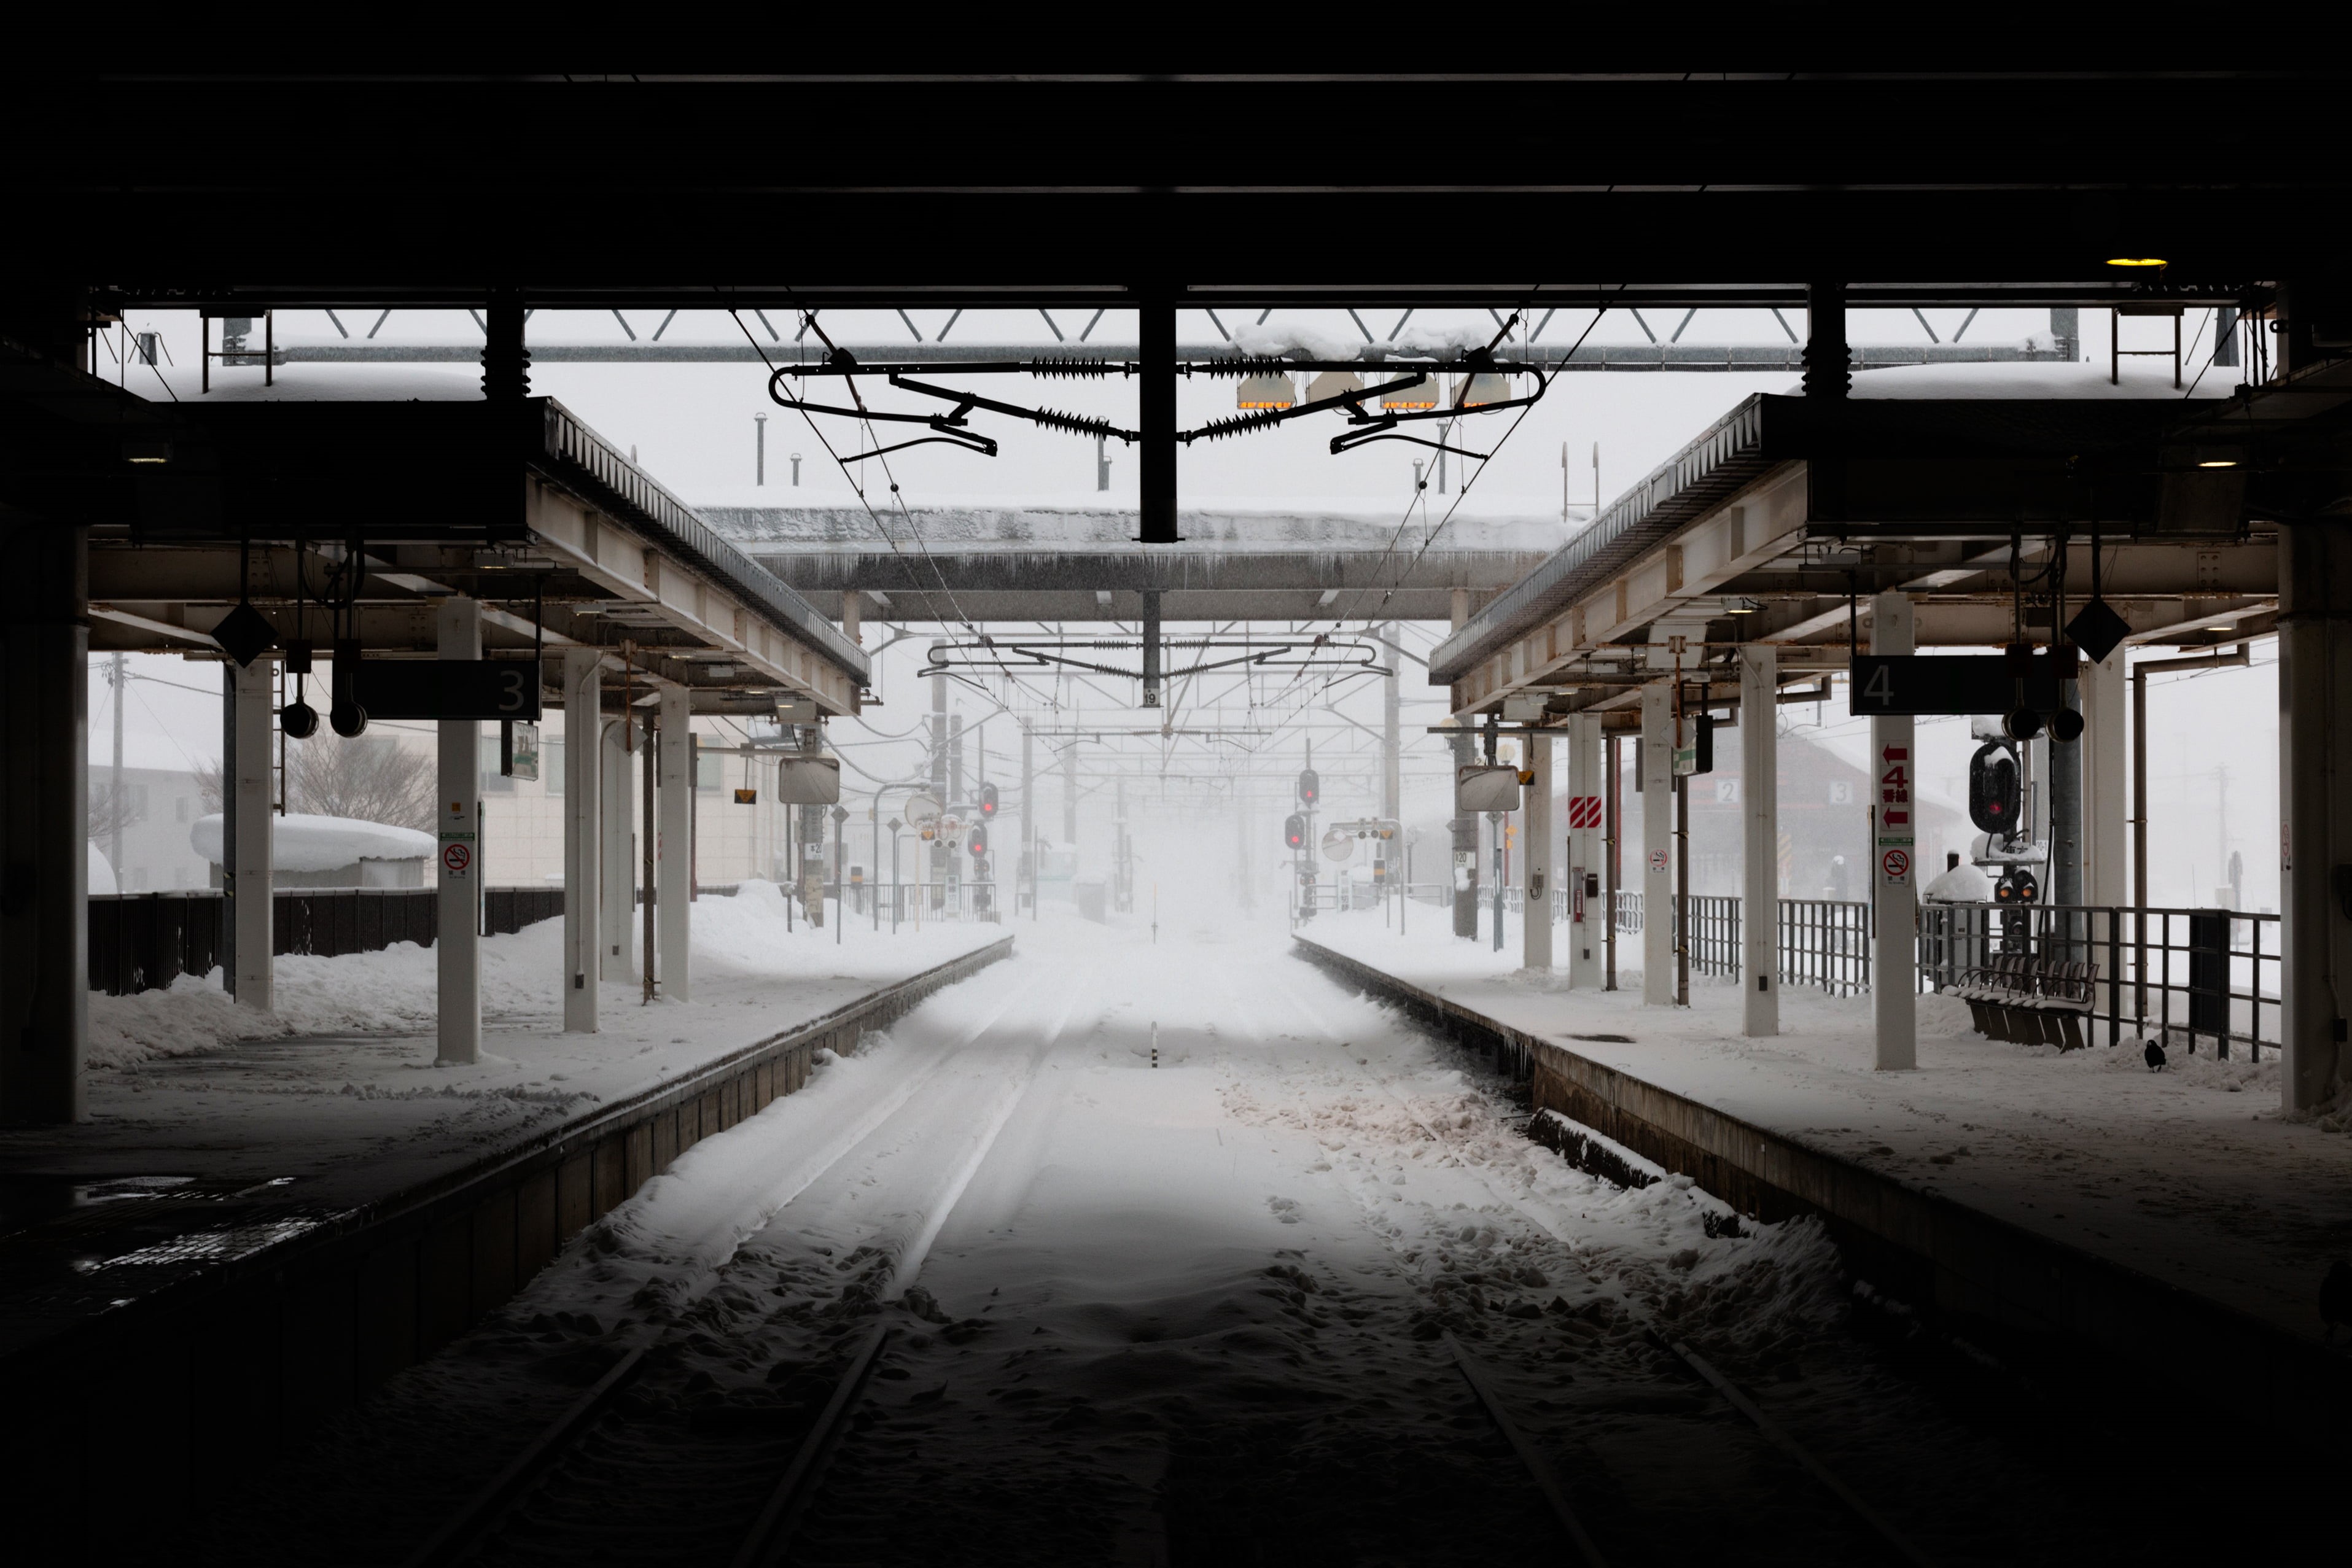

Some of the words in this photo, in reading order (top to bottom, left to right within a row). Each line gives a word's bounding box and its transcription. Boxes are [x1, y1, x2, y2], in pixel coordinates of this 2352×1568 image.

[498, 670, 525, 712] 3
[1864, 664, 1894, 706] 4
[1882, 766, 1908, 788] 4
[1722, 783, 1734, 801] 2
[1835, 783, 1847, 802] 3
[1882, 789, 1908, 803] 番線
